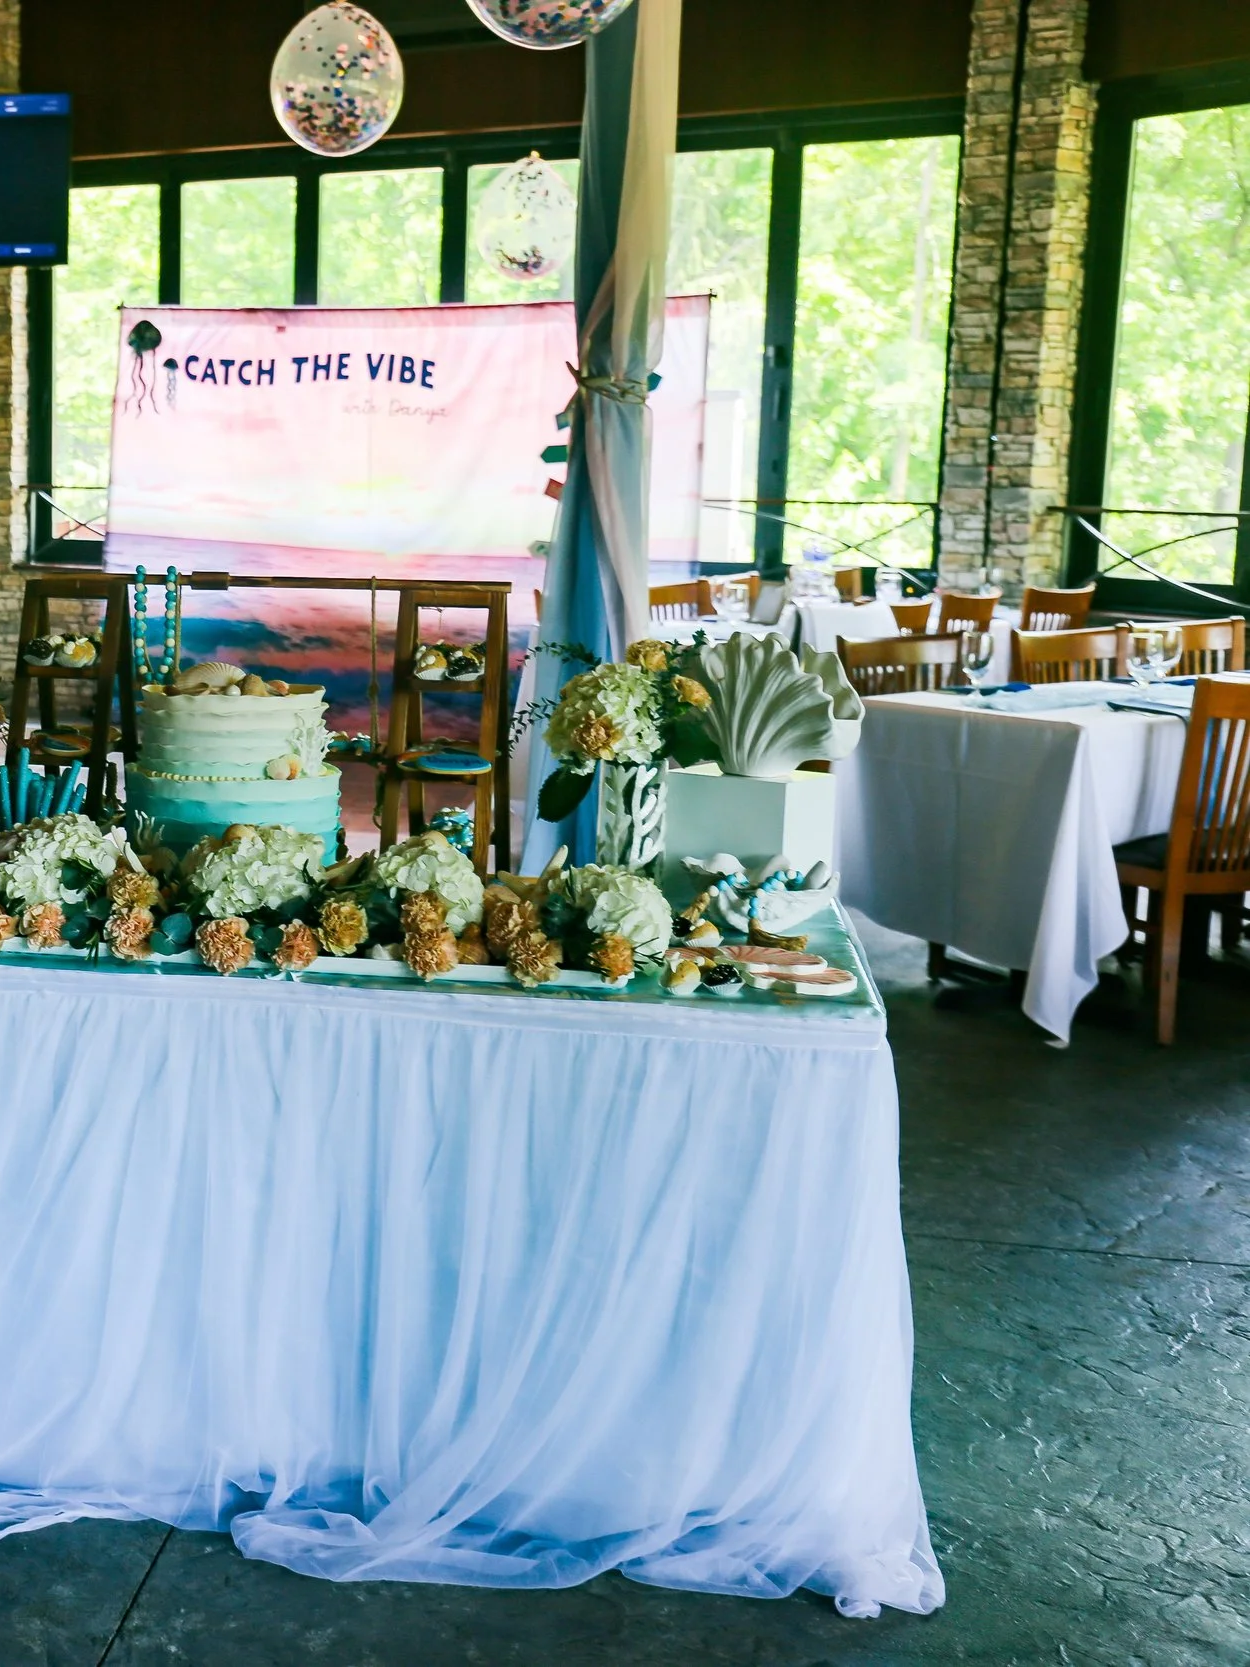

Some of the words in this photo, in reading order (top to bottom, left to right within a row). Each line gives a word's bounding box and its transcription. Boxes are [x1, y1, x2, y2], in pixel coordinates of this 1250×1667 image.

[184, 354, 276, 386] CATCH
[291, 352, 352, 384] THE
[365, 352, 436, 390] VIBE
